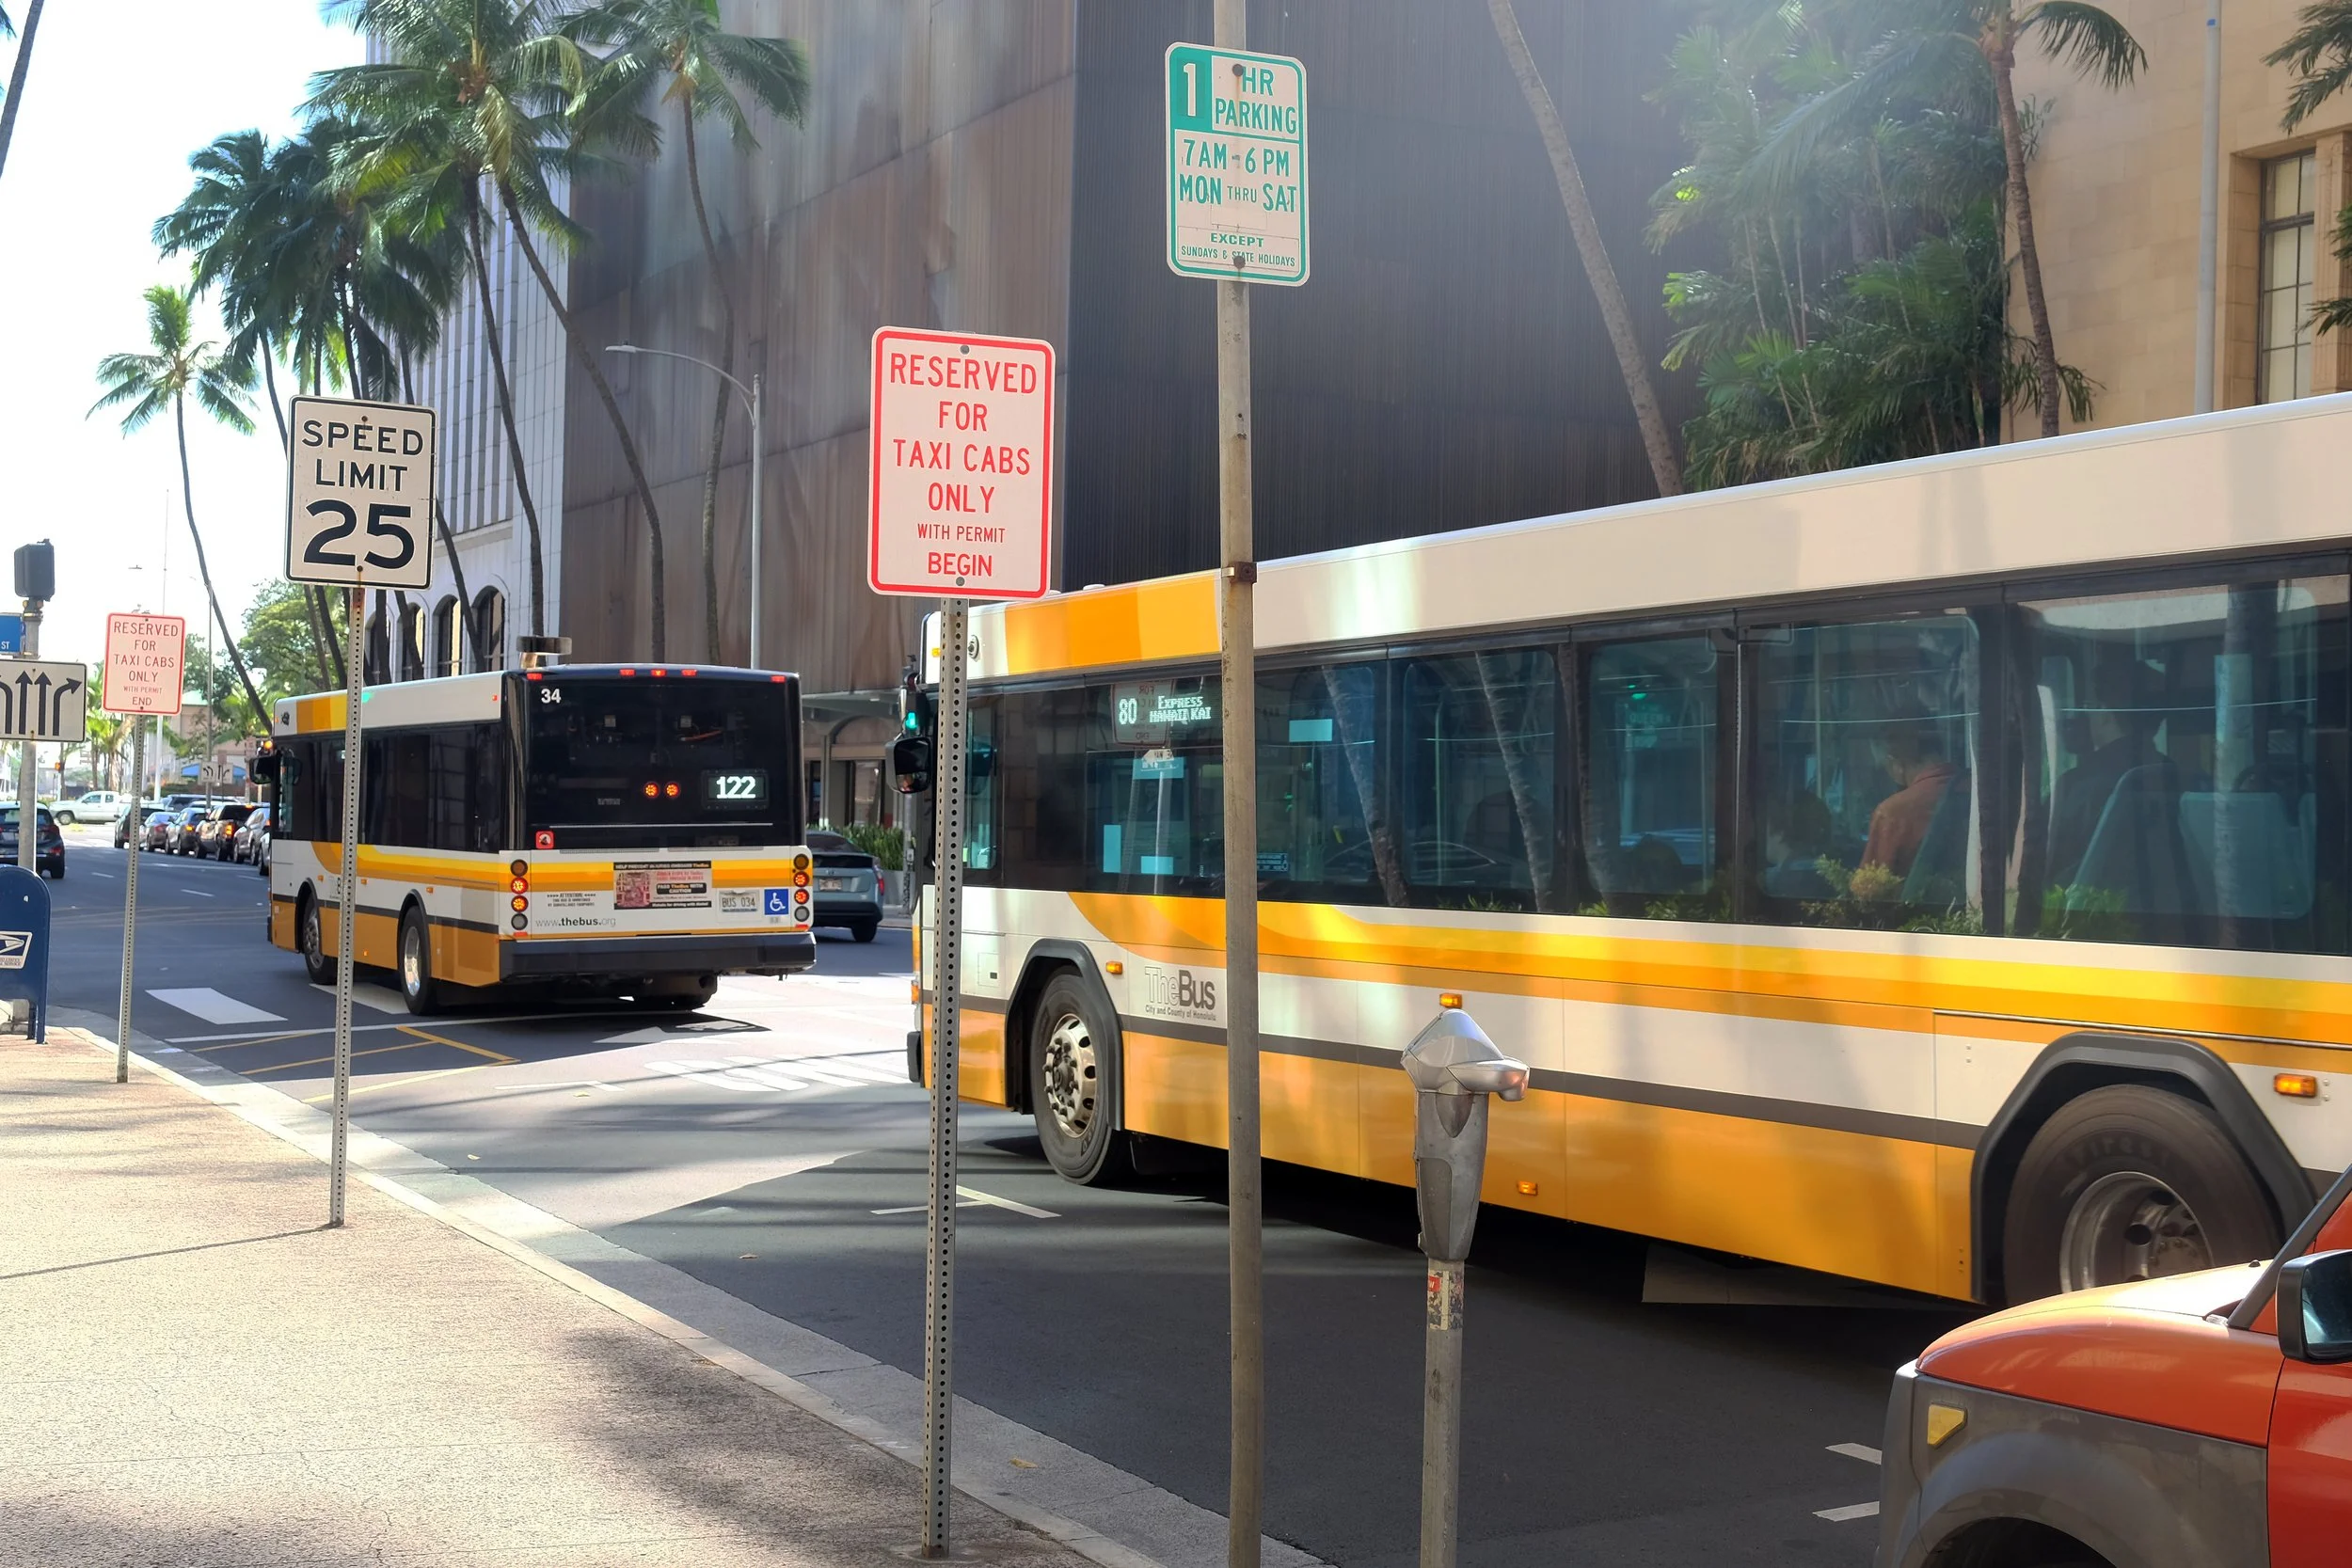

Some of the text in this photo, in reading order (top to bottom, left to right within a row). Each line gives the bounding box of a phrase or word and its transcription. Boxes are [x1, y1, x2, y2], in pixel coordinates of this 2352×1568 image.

[1183, 62, 1274, 117] 1 HR
[1215, 98, 1296, 135] PARKING
[1179, 174, 1296, 213] MON THRU SAT
[1210, 232, 1264, 247] EXCEPT
[1181, 245, 1218, 259] SUNDAYS
[1222, 249, 1228, 260] &
[1258, 254, 1295, 267] HOLIDAYS
[890, 353, 1036, 394] RESERVED
[939, 401, 988, 432] FOR
[301, 420, 423, 456] SPEED
[893, 438, 1030, 475] TAXI CABS
[315, 458, 408, 492] LIMIT
[928, 482, 994, 514] ONLY
[303, 499, 415, 570] 25
[917, 523, 1006, 544] WITH PERMIT
[928, 551, 993, 578] BEGIN
[113, 622, 179, 637] RESERVED
[1, 641, 10, 650] ST
[135, 640, 156, 651] FOR
[114, 654, 174, 668] TAXI CABS
[128, 670, 158, 683] ONLY
[132, 696, 152, 705] END
[140, 686, 163, 694] PERMIT
[541, 688, 562, 704] 34
[1119, 698, 1137, 724] 80
[1190, 706, 1212, 721] KAI
[716, 775, 756, 800] 122
[722, 897, 755, 908] BUS 034
[535, 917, 616, 927] www.thebus.org
[1144, 966, 1216, 1010] TheBus
[1145, 1005, 1155, 1015] City
[1157, 1006, 1167, 1015] and
[1168, 1006, 1185, 1019] County
[1186, 1009, 1192, 1019] of
